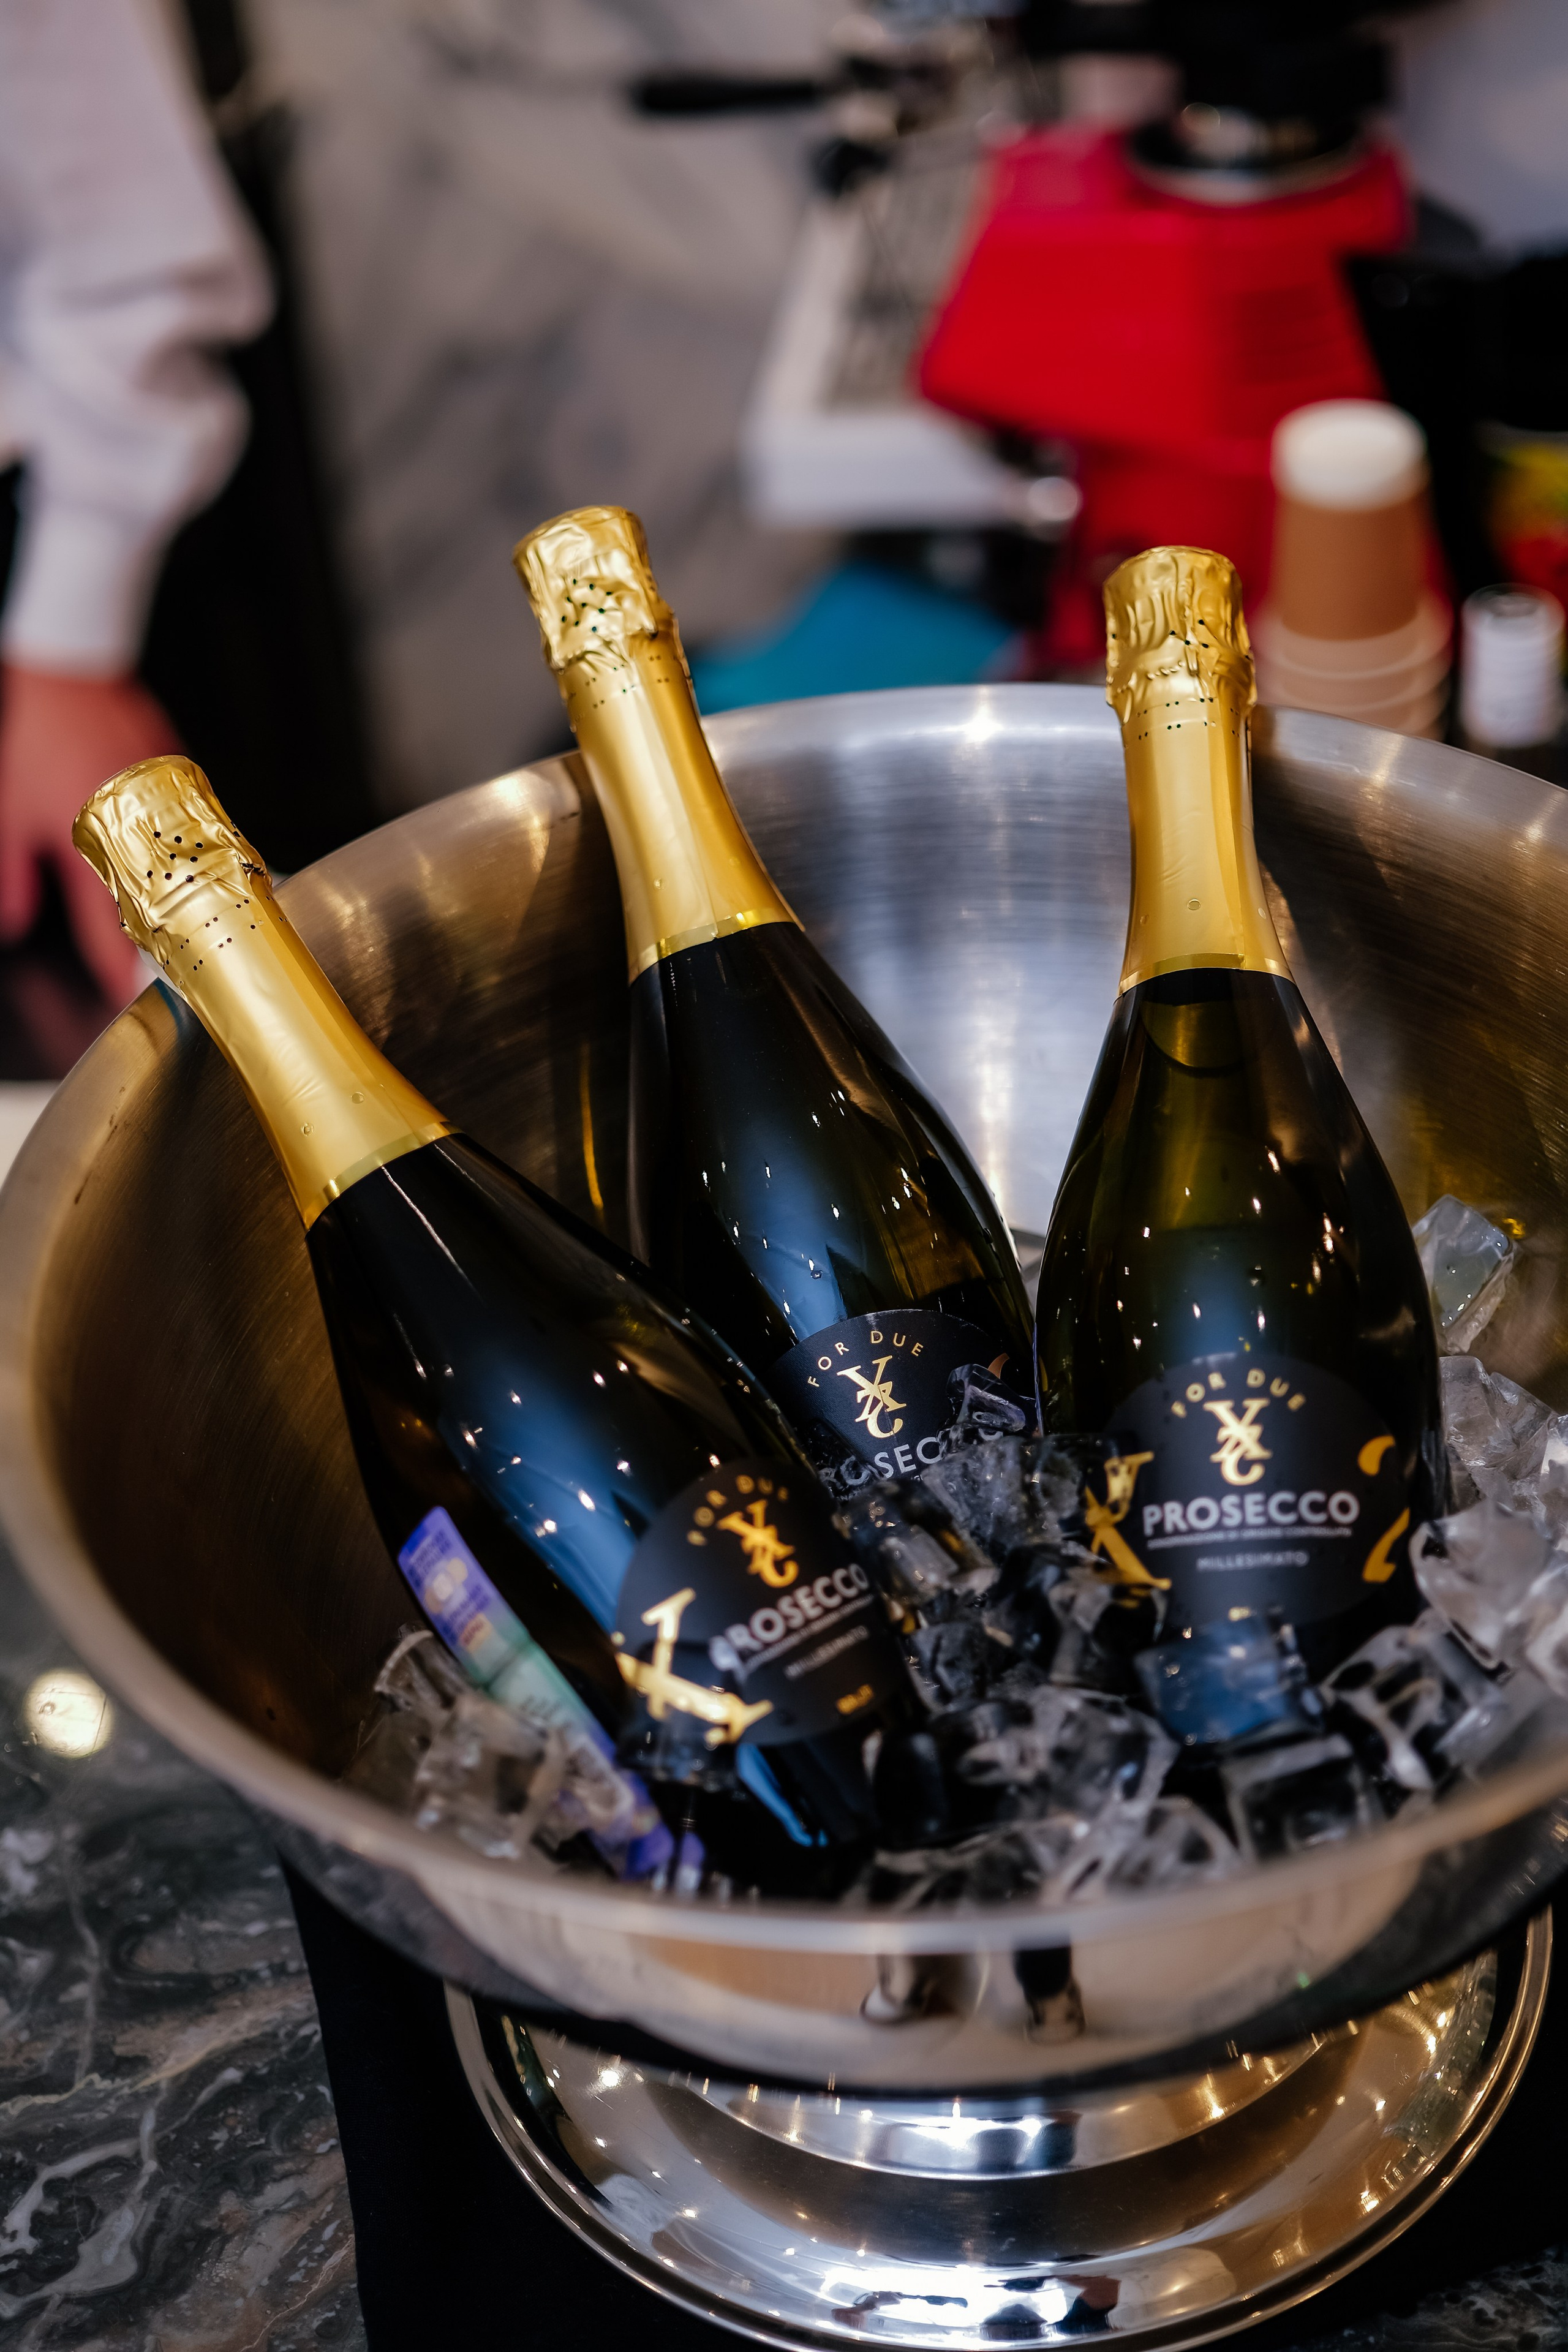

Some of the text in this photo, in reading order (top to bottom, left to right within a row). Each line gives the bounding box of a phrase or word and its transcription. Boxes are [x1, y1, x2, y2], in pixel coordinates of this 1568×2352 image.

[807, 1330, 924, 1388] FOR DUE
[1170, 1367, 1306, 1419] FOR DUE
[1143, 1490, 1360, 1536] PROSECCO
[1196, 1550, 1310, 1572] MILLESIMATO
